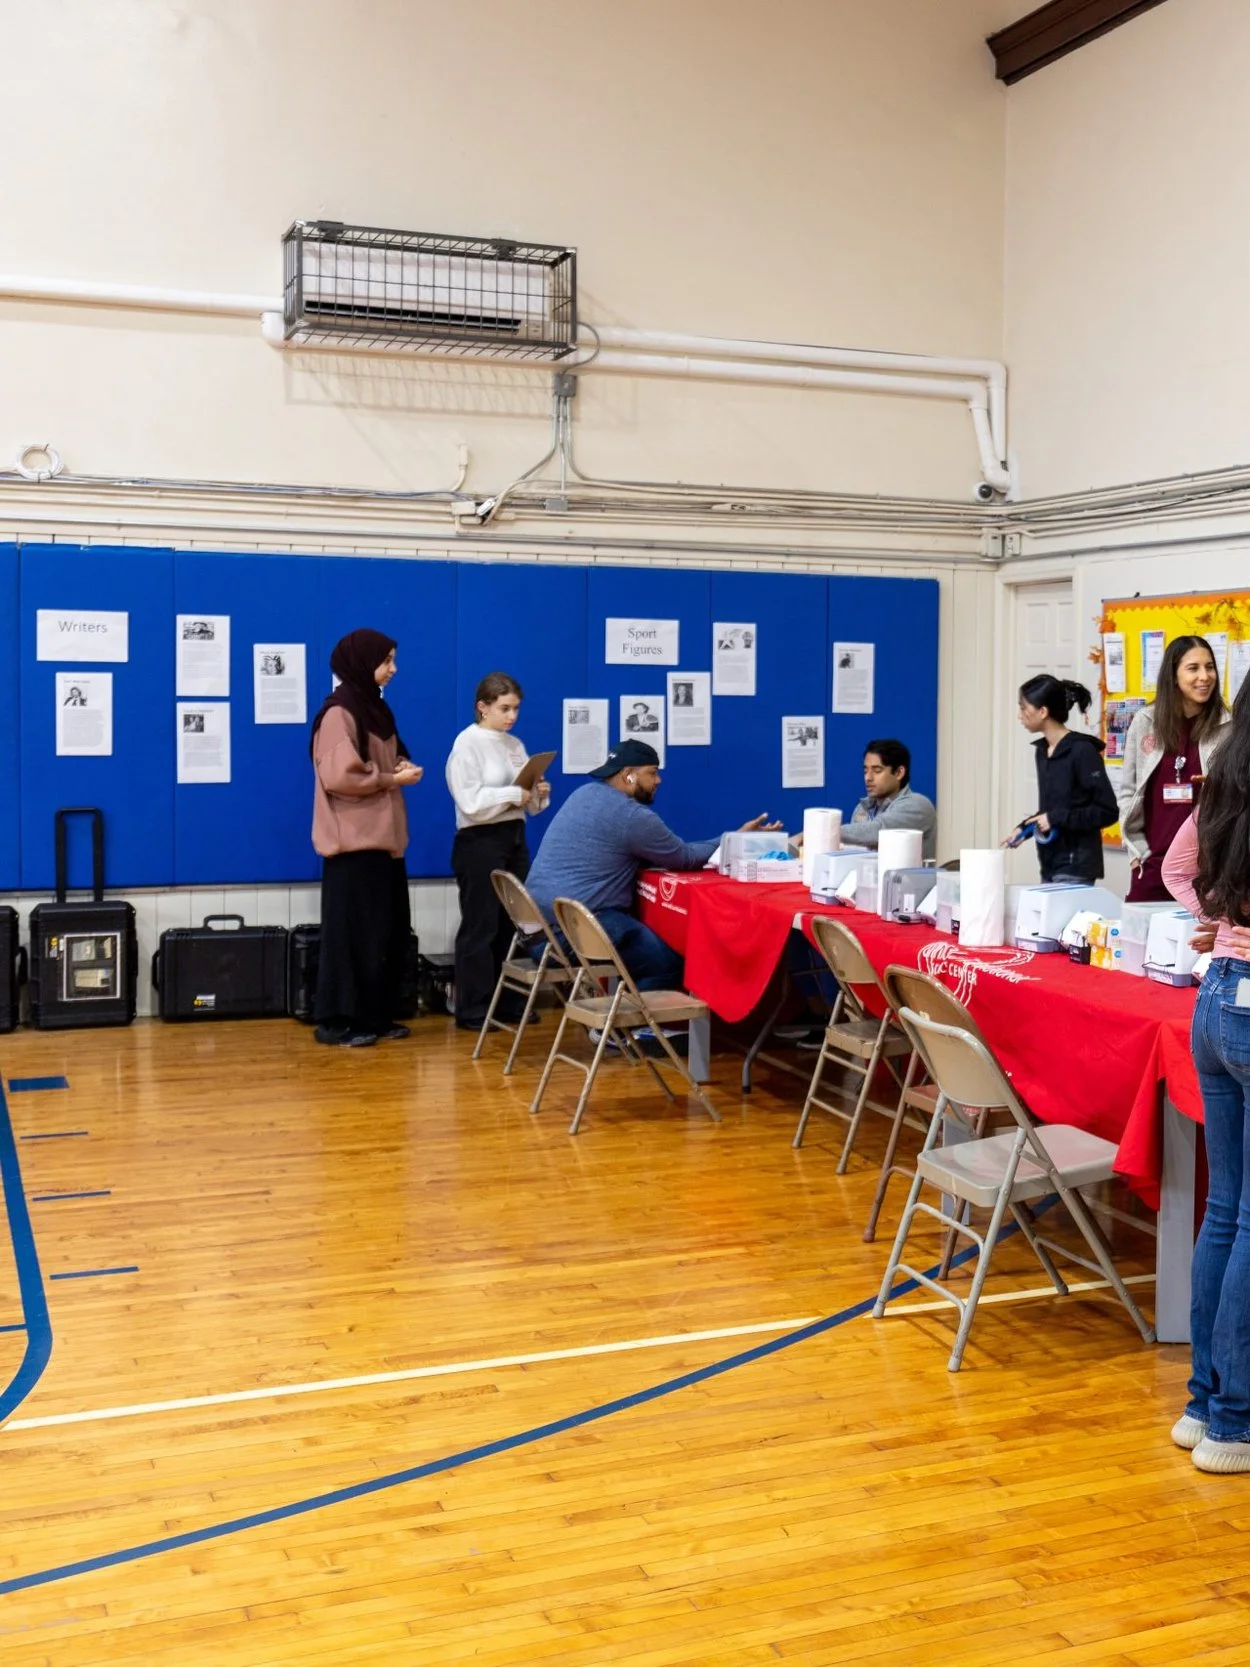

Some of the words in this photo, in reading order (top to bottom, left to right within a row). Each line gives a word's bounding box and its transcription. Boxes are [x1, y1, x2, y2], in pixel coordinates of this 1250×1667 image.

[58, 620, 108, 633] Writers
[627, 626, 657, 641] Sport
[622, 642, 663, 657] Figures
